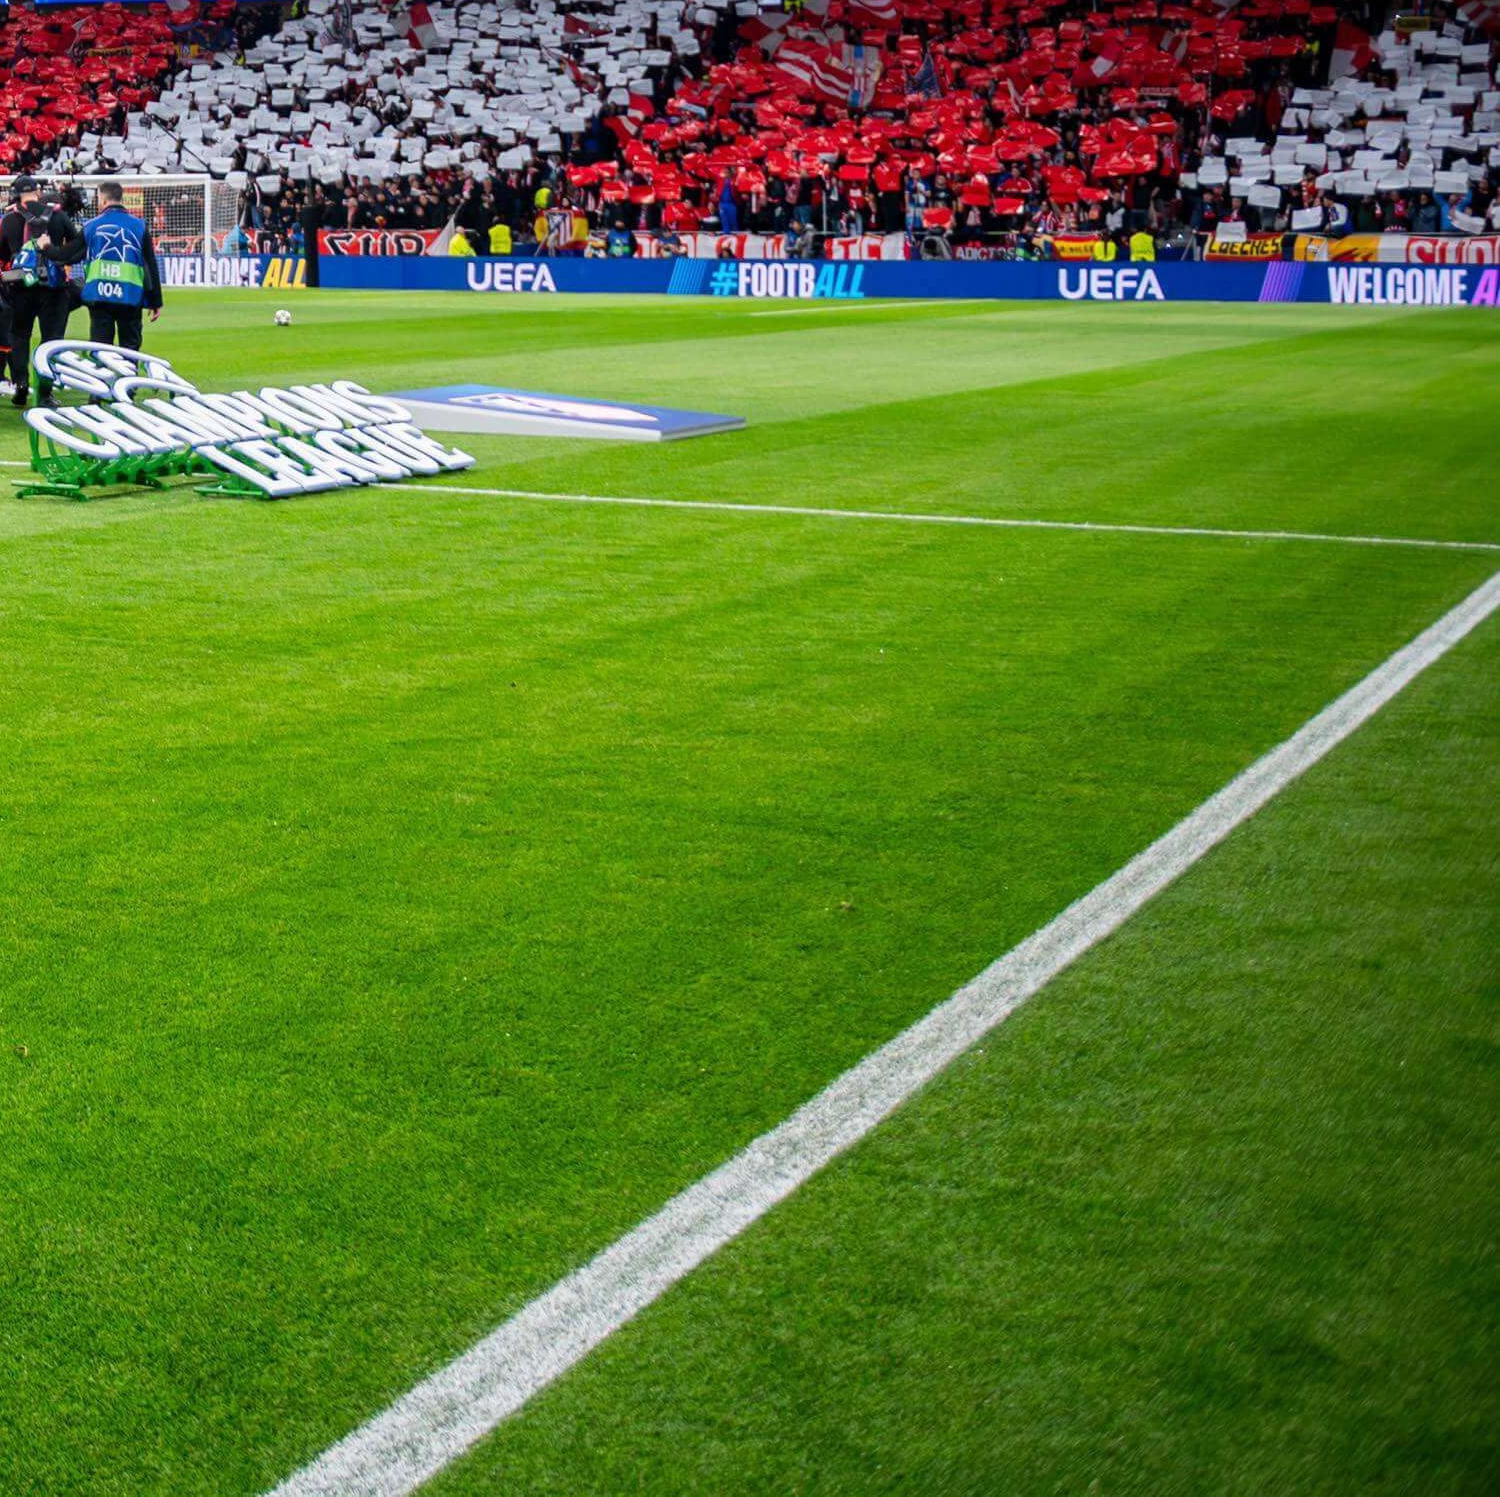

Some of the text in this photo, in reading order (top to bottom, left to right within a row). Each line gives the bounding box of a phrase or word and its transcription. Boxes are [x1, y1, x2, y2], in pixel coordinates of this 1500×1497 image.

[955, 246, 1016, 261] ADICTOS
[100, 262, 121, 277] HB
[262, 257, 307, 288] ALL
[467, 262, 557, 292] UEFA
[710, 262, 865, 297] #FOOTBALL
[1058, 268, 1165, 300] UEFA
[97, 281, 123, 298] 004
[1327, 267, 1468, 305] WELCOME
[23, 379, 413, 459] CHAMPIONS
[193, 421, 477, 498] LEAGUE
